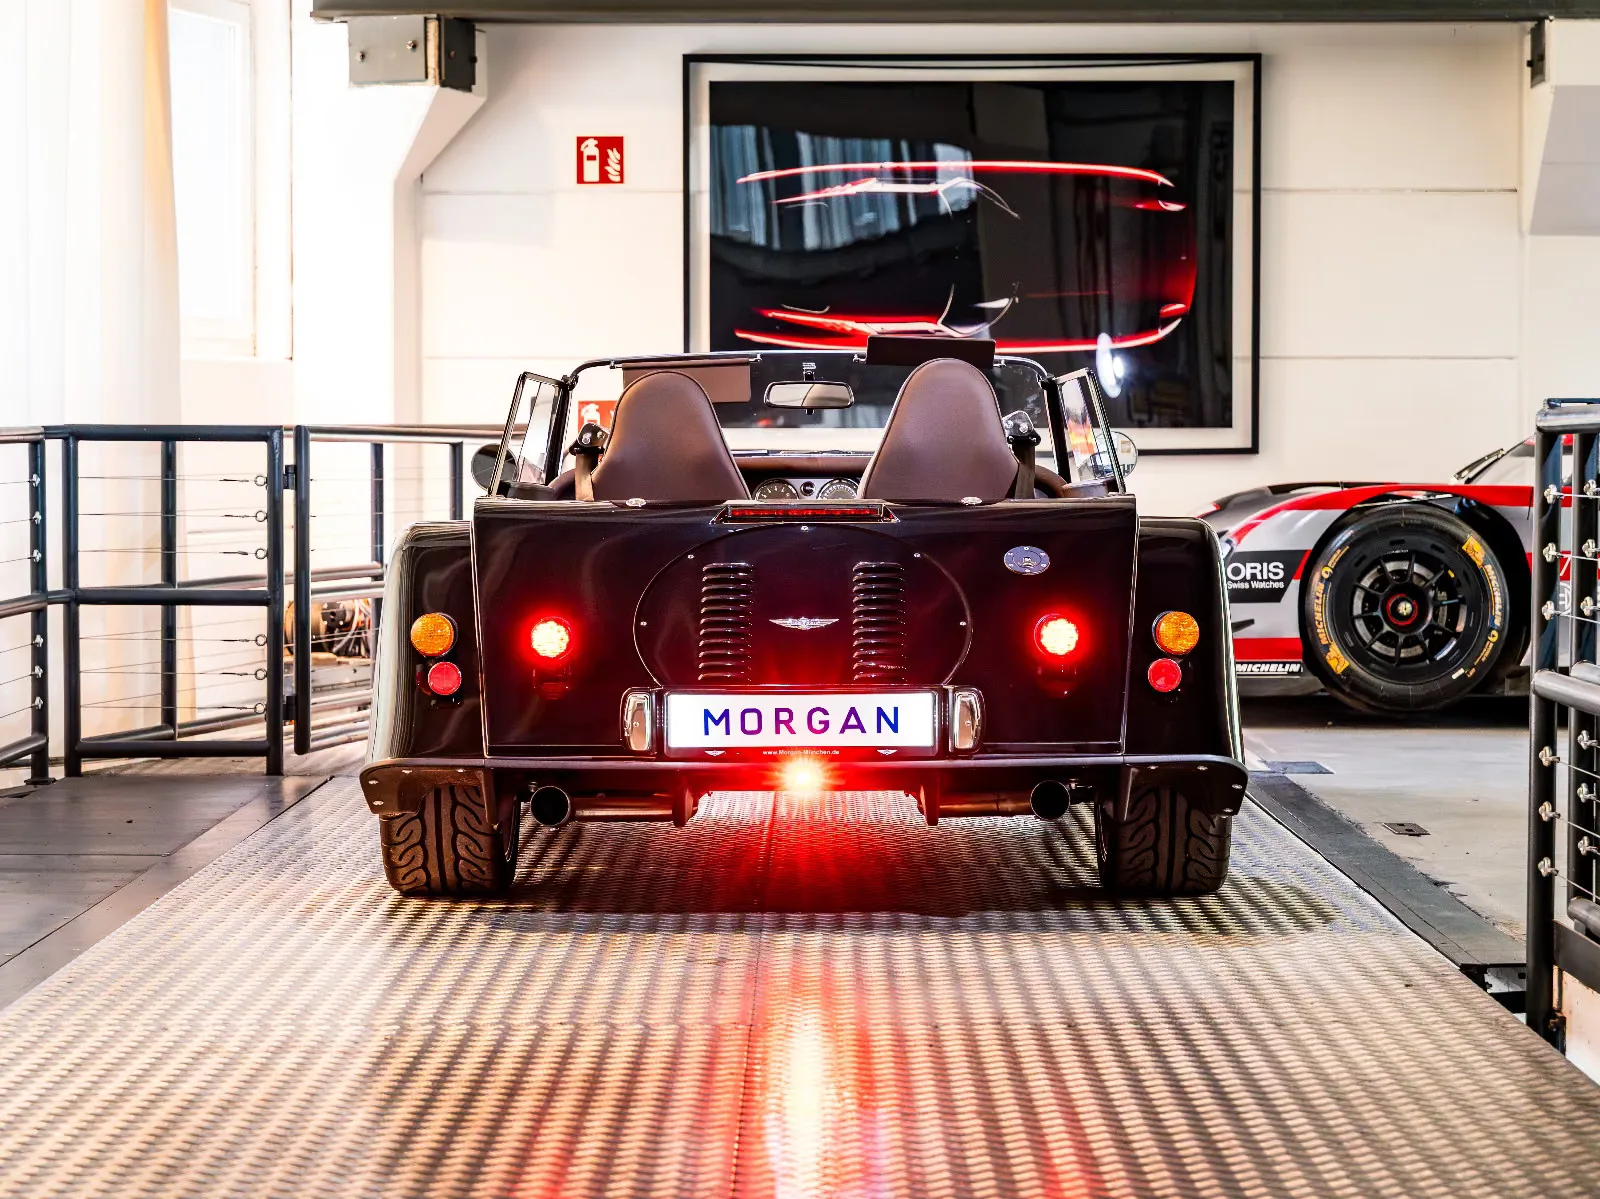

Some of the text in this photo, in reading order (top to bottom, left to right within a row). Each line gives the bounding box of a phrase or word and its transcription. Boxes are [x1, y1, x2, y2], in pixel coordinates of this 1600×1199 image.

[1226, 562, 1284, 580] ORIS
[1227, 581, 1284, 589] Swiss Watches
[1314, 581, 1328, 645] MICHELIN
[1236, 663, 1300, 673] MICHELIN
[703, 707, 898, 735] MORGAN
